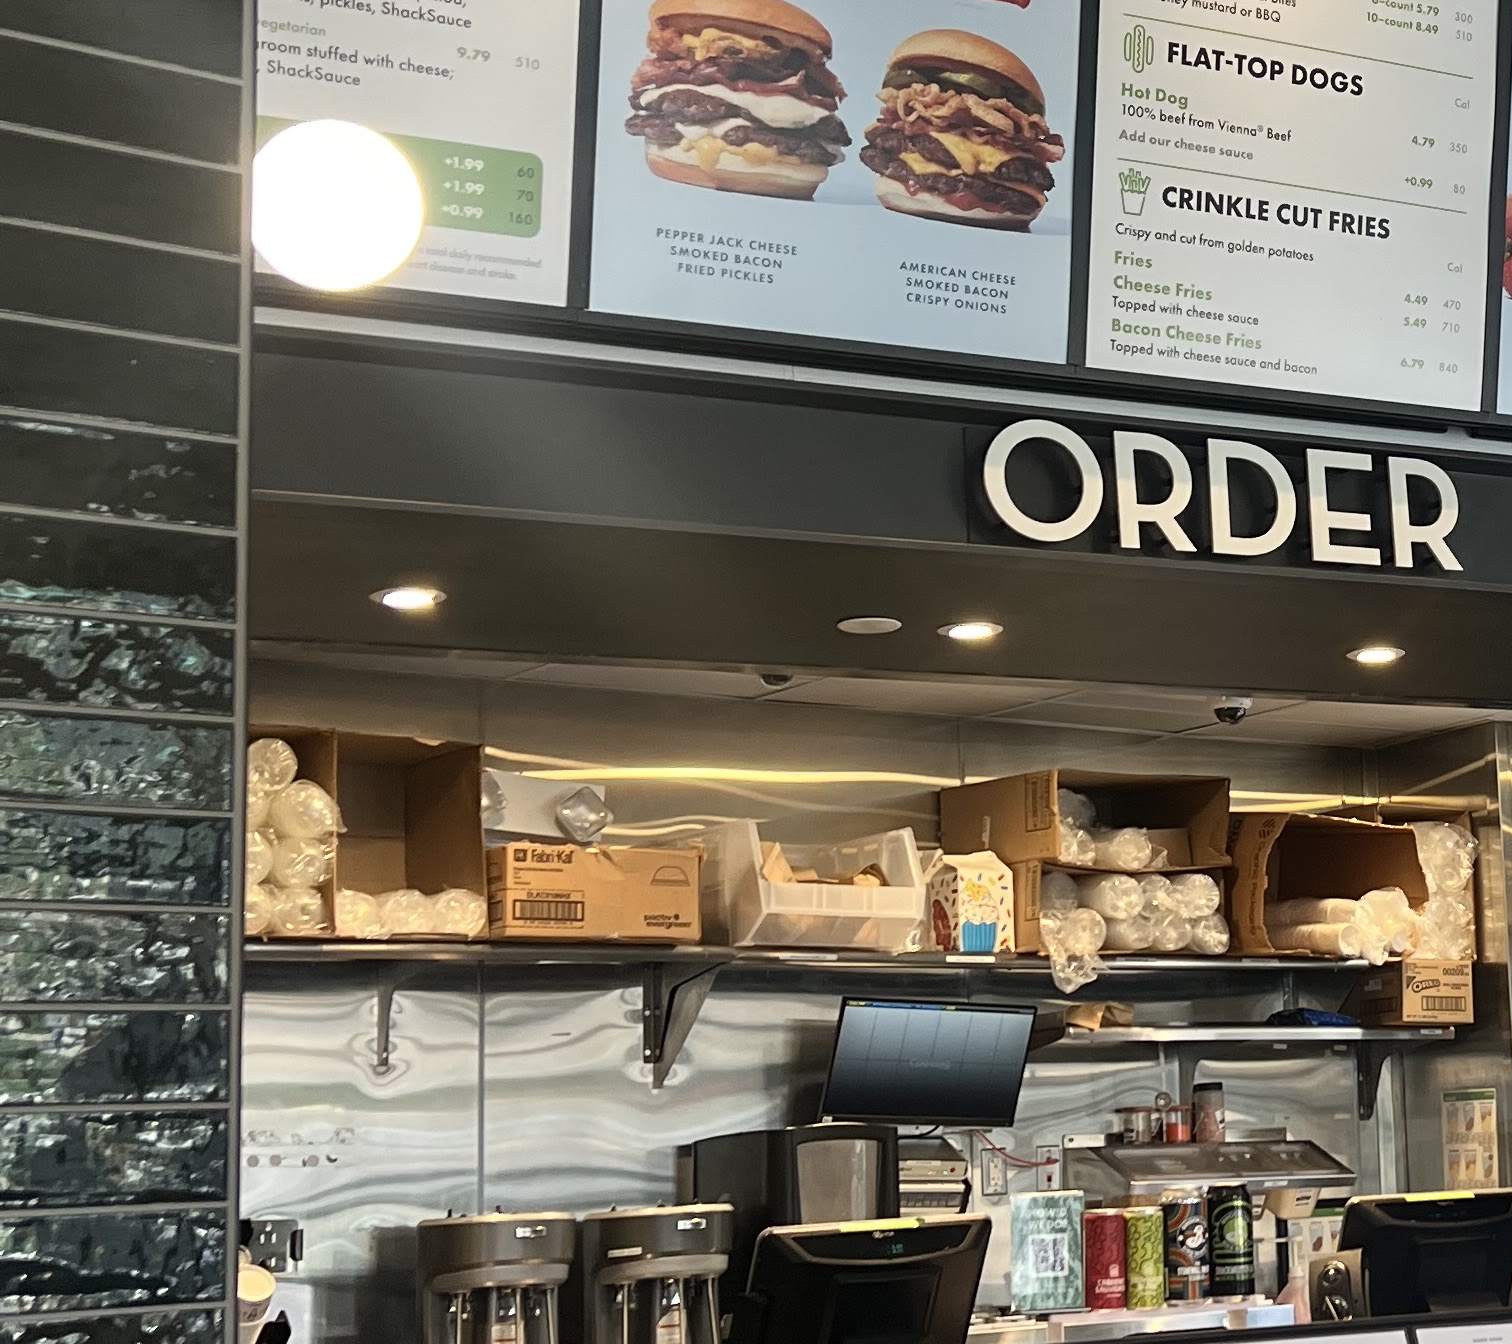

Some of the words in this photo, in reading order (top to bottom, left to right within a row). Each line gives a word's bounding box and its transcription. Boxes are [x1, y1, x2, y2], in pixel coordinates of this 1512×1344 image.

[380, 1, 471, 28] ShackSauce
[1167, 41, 1284, 80] FLAT-TOP
[1291, 63, 1363, 96] DOGS
[1121, 82, 1151, 100] Hot
[1155, 87, 1188, 110] Dog
[1118, 128, 1145, 143] Add
[1148, 136, 1171, 146] our
[1173, 137, 1215, 154] cheese
[1218, 147, 1253, 160] sauce
[1161, 185, 1269, 221] CRINKLE
[1276, 203, 1322, 229] CUT
[1328, 210, 1390, 239] FRIES
[656, 227, 704, 243] PEPPER
[708, 234, 743, 248] JACK
[748, 239, 797, 255] CHEESE
[669, 245, 728, 261] SMOKED
[734, 253, 782, 269] BACON
[677, 262, 715, 276] FRIED
[720, 267, 773, 283] PICKLES
[899, 261, 966, 278] AMERICAN
[971, 270, 1015, 285] CHEESE
[1114, 250, 1152, 268] Fries
[1403, 293, 1428, 305] 4.49
[905, 276, 959, 292] SMOKED
[964, 284, 1008, 299] BACON
[1113, 274, 1170, 295] Cheese
[1175, 282, 1212, 300] Fries
[1402, 316, 1426, 328] 5.49
[906, 292, 949, 306] CRISPY
[954, 298, 1006, 314] ONIONS
[983, 419, 1464, 571] ORDER
